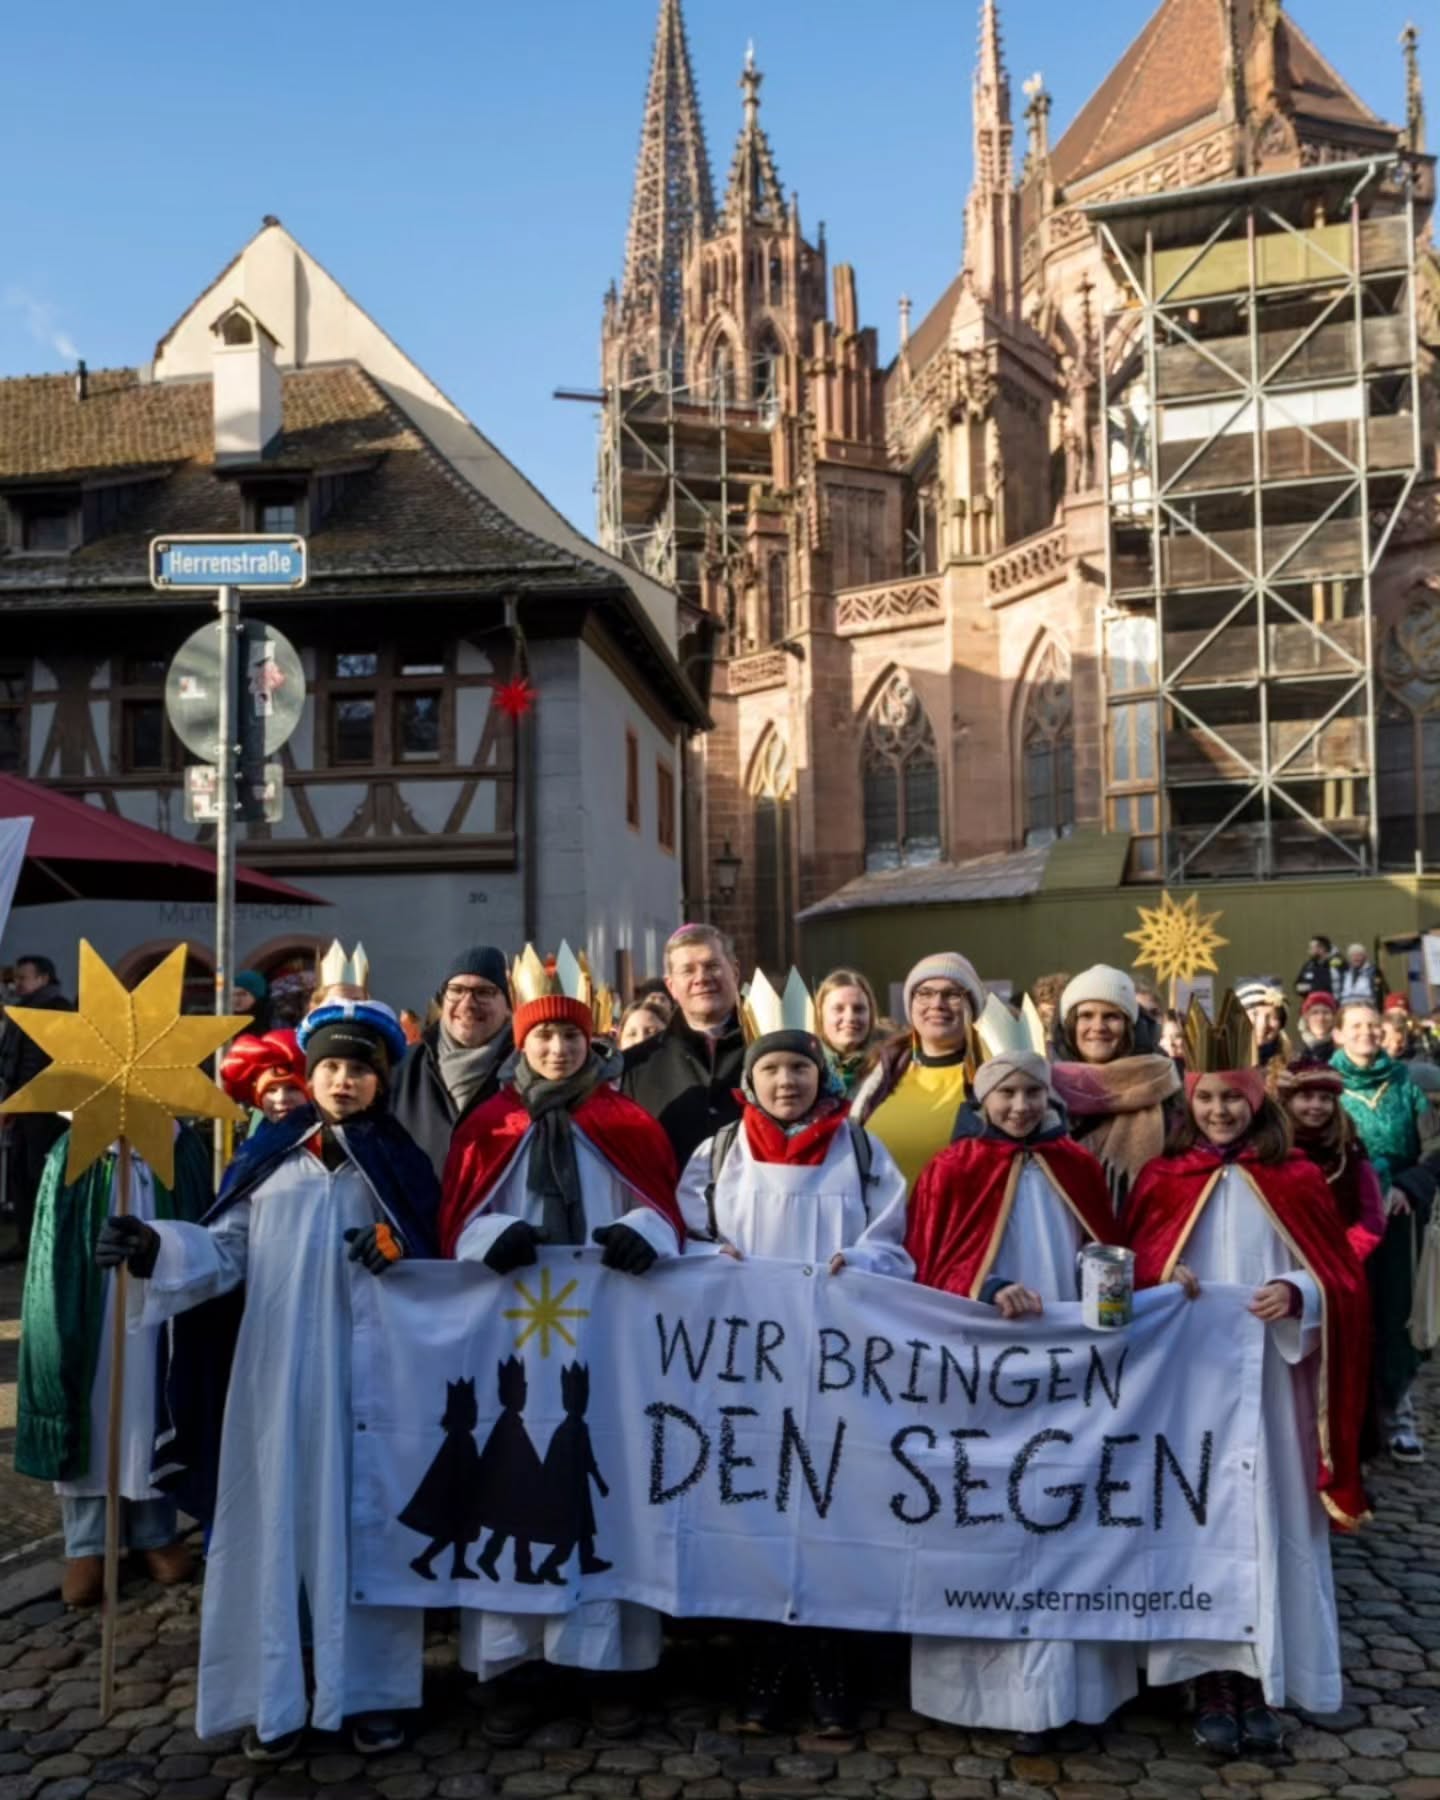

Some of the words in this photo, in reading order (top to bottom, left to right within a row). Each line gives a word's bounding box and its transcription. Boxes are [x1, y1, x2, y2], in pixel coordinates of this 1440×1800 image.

[170, 550, 292, 574] Herrenstraße
[655, 1312, 786, 1384] WIR
[817, 1327, 1130, 1409] BRINGEN
[643, 1400, 847, 1520] DEN
[888, 1424, 1213, 1536] SEGEN
[943, 1583, 1214, 1619] www.sternsinger.de
